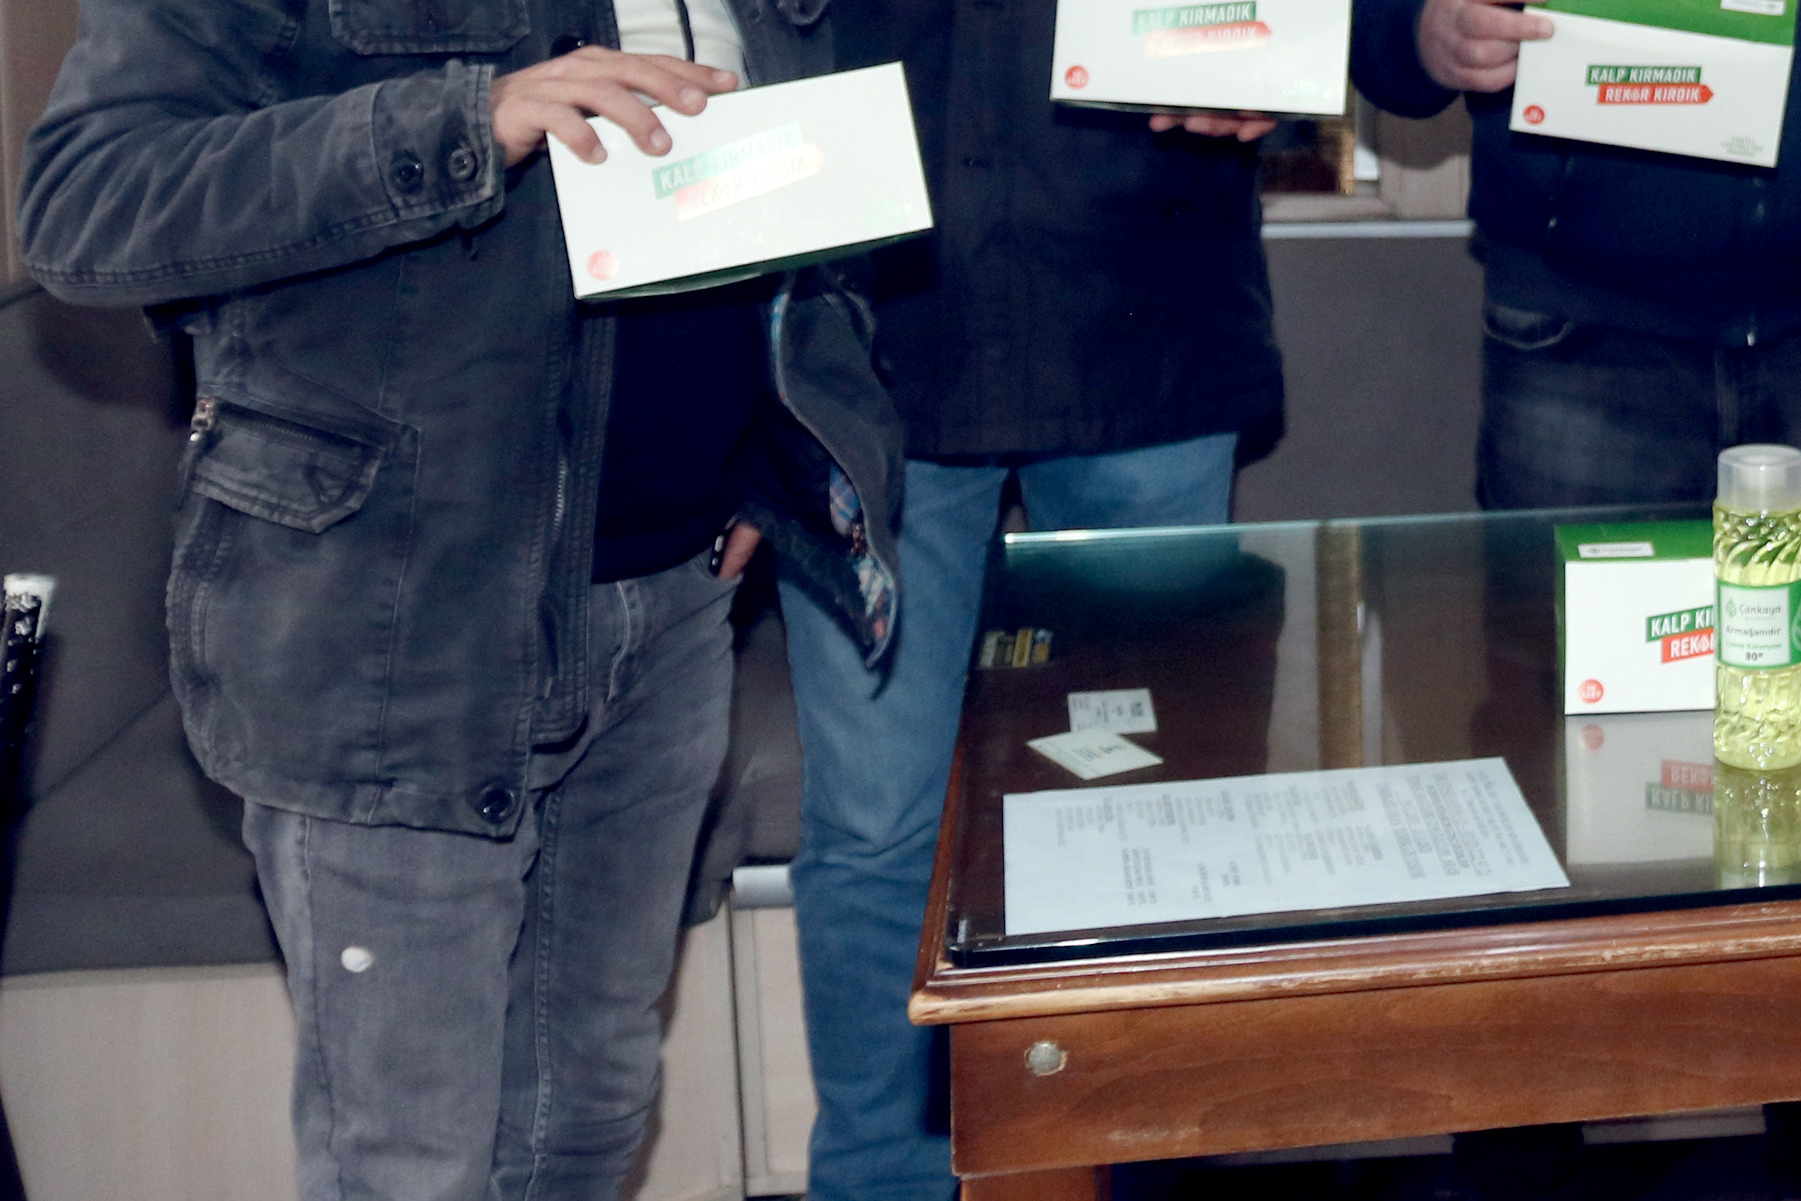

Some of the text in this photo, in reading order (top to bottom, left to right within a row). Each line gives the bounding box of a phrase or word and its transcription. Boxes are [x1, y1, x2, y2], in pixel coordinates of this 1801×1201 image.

[1179, 3, 1252, 26] KIRMADIK
[1590, 67, 1698, 84] KALP KIRMADIK
[1653, 86, 1701, 103] KIRDIK
[1651, 612, 1691, 637] KALP
